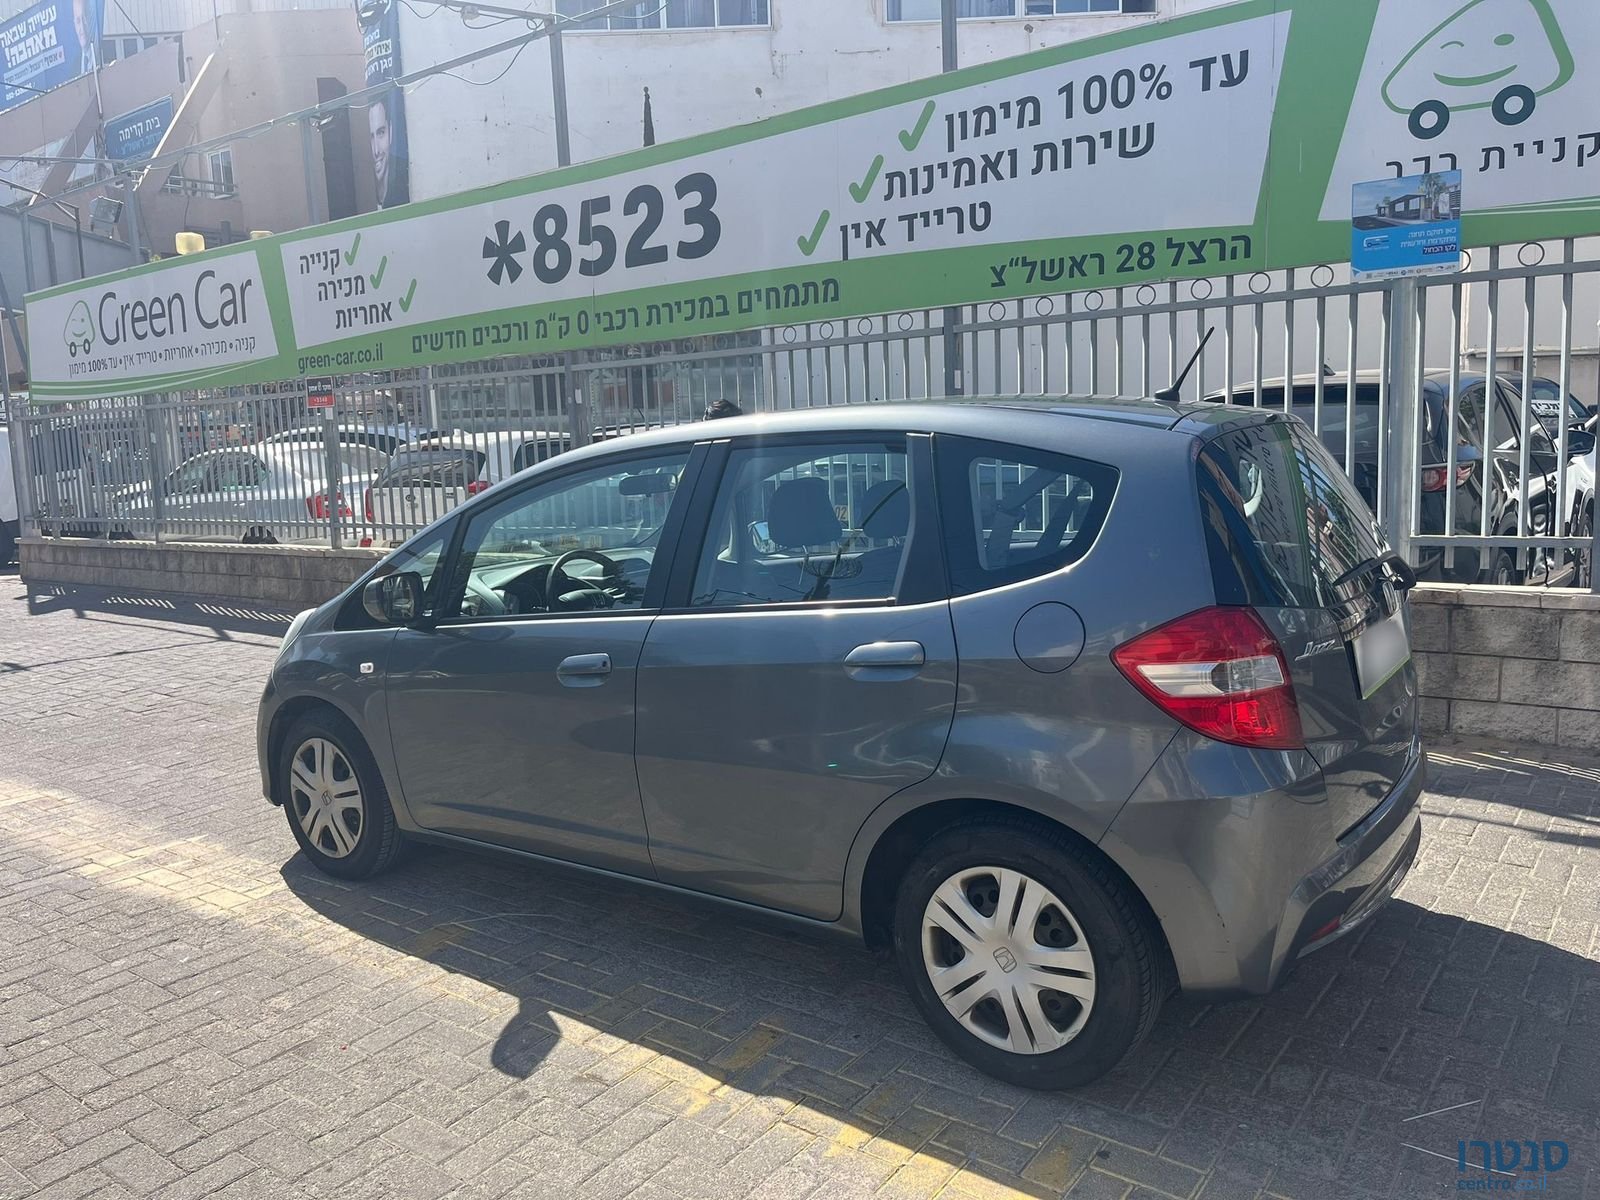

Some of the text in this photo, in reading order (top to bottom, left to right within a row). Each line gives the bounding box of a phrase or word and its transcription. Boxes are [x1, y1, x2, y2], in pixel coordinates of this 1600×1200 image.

[28, 5, 57, 34] עשייה
[4, 26, 58, 68] מאהבה!
[945, 49, 1250, 152] עד 100% מימון
[146, 116, 160, 131] בית
[884, 122, 1155, 201] שירות ואמינות
[840, 201, 992, 261] טרייד אין
[300, 248, 340, 275] קנייה
[1116, 241, 1156, 272] 28
[1166, 234, 1252, 267] הרצל
[318, 275, 366, 301] מכירה
[737, 278, 840, 314] מתמחים
[98, 270, 252, 346] Green Car
[335, 301, 393, 329] אחריות
[577, 310, 589, 335] 0
[595, 307, 639, 332] רכבי
[645, 295, 729, 327] במכירת
[412, 329, 466, 353] חדשים
[473, 321, 528, 346] ורכבים
[69, 337, 256, 378] קניה מכירה אחריות טרייד אין עד 100% מימון
[298, 342, 383, 374] green-car.co.il
